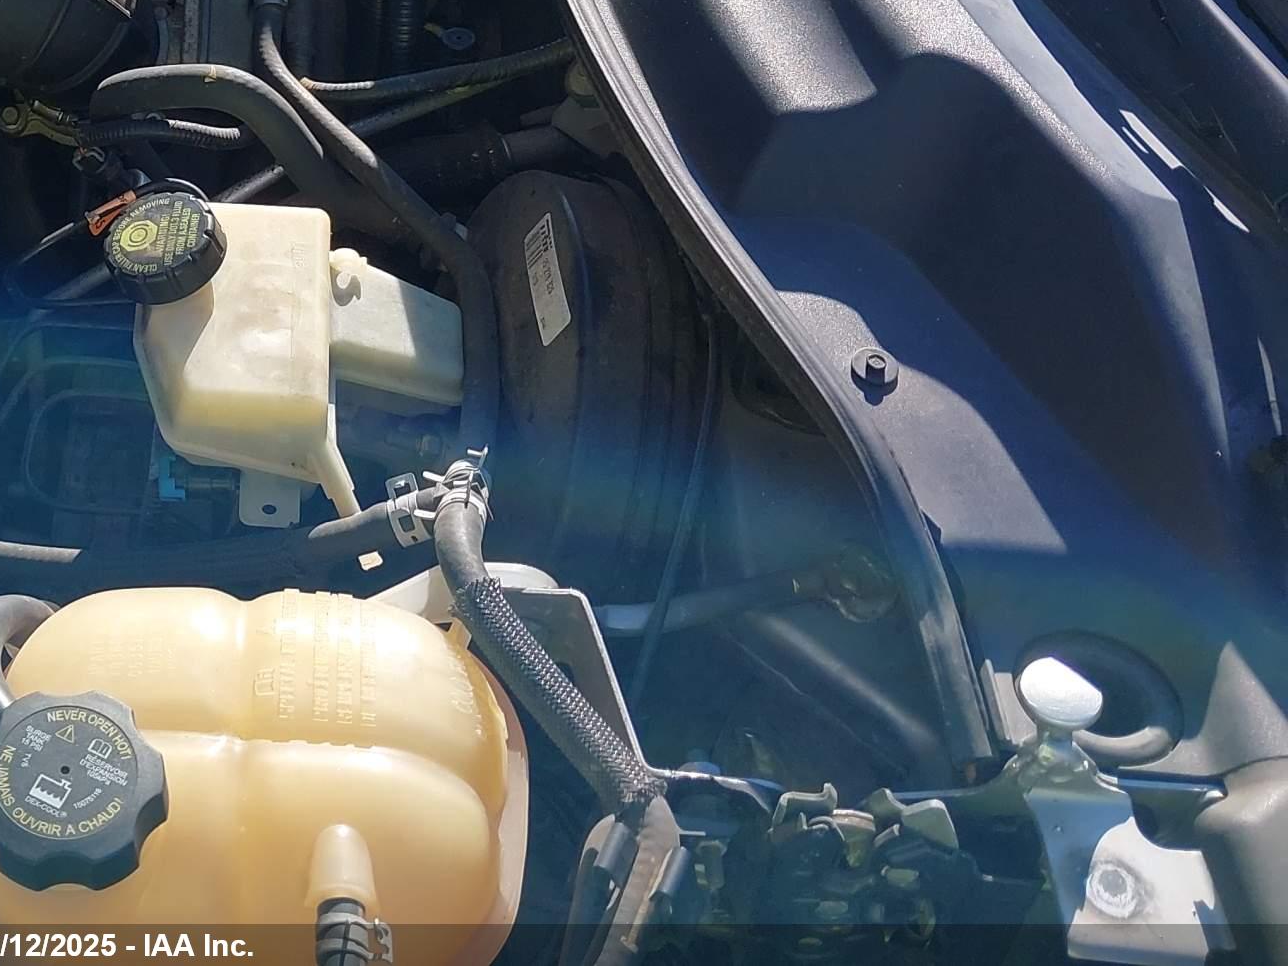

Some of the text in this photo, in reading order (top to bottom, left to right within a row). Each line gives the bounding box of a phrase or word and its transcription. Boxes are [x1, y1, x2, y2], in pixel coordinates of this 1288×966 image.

[172, 200, 183, 217] FLUID
[180, 207, 191, 230] SEALED
[112, 197, 171, 273] CLEAN FILLER CAP BEFORE REMOVING
[155, 214, 170, 252] WARNING!
[186, 213, 200, 248] CONTAINER
[166, 235, 177, 252] ONLY
[176, 236, 186, 255] FROM
[164, 252, 173, 266] USE
[25, 725, 52, 742] SURGE
[26, 732, 44, 745] TANK
[47, 710, 132, 760] NEVER OPEN HOT!
[29, 741, 44, 752] PSI
[79, 758, 128, 786] D'EXPANSION
[0, 745, 17, 764] NE
[12, 807, 62, 837] OUVRIR
[78, 797, 124, 833] CHAUD!
